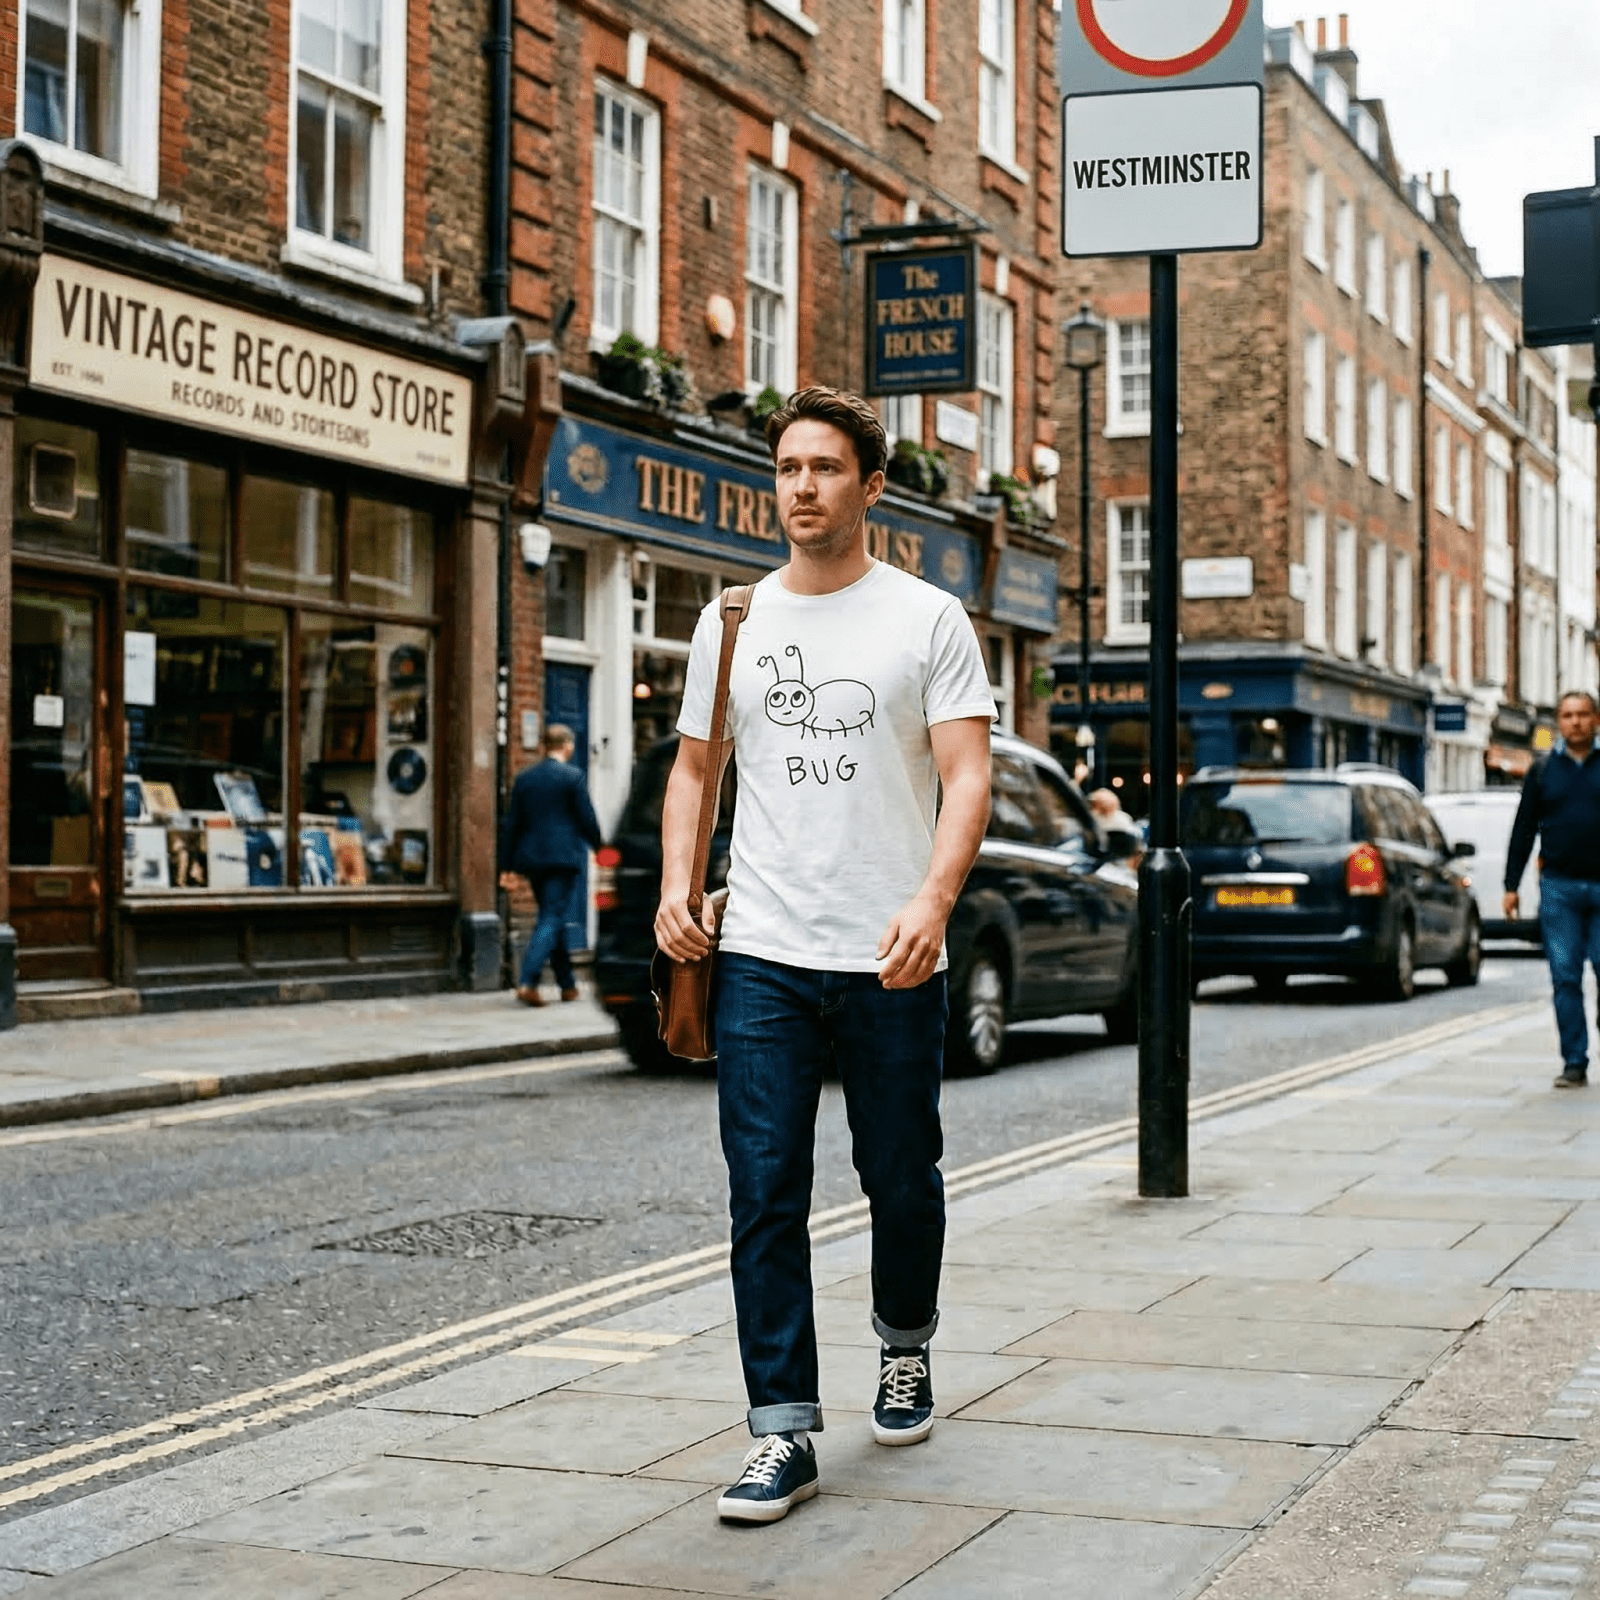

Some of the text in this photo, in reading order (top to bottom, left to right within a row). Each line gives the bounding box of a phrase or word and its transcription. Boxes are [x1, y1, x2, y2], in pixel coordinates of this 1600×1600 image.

[1073, 151, 1250, 189] WESTMINSTER
[901, 265, 939, 290] The
[877, 293, 964, 325] FRENCH
[56, 279, 454, 436] VINTAGE RECORD STORE
[885, 327, 957, 358] HOUSE
[172, 381, 244, 417] RECORDS
[252, 402, 284, 426] AND
[635, 455, 925, 577] THE FRE OUSE
[786, 754, 858, 786] BUG
